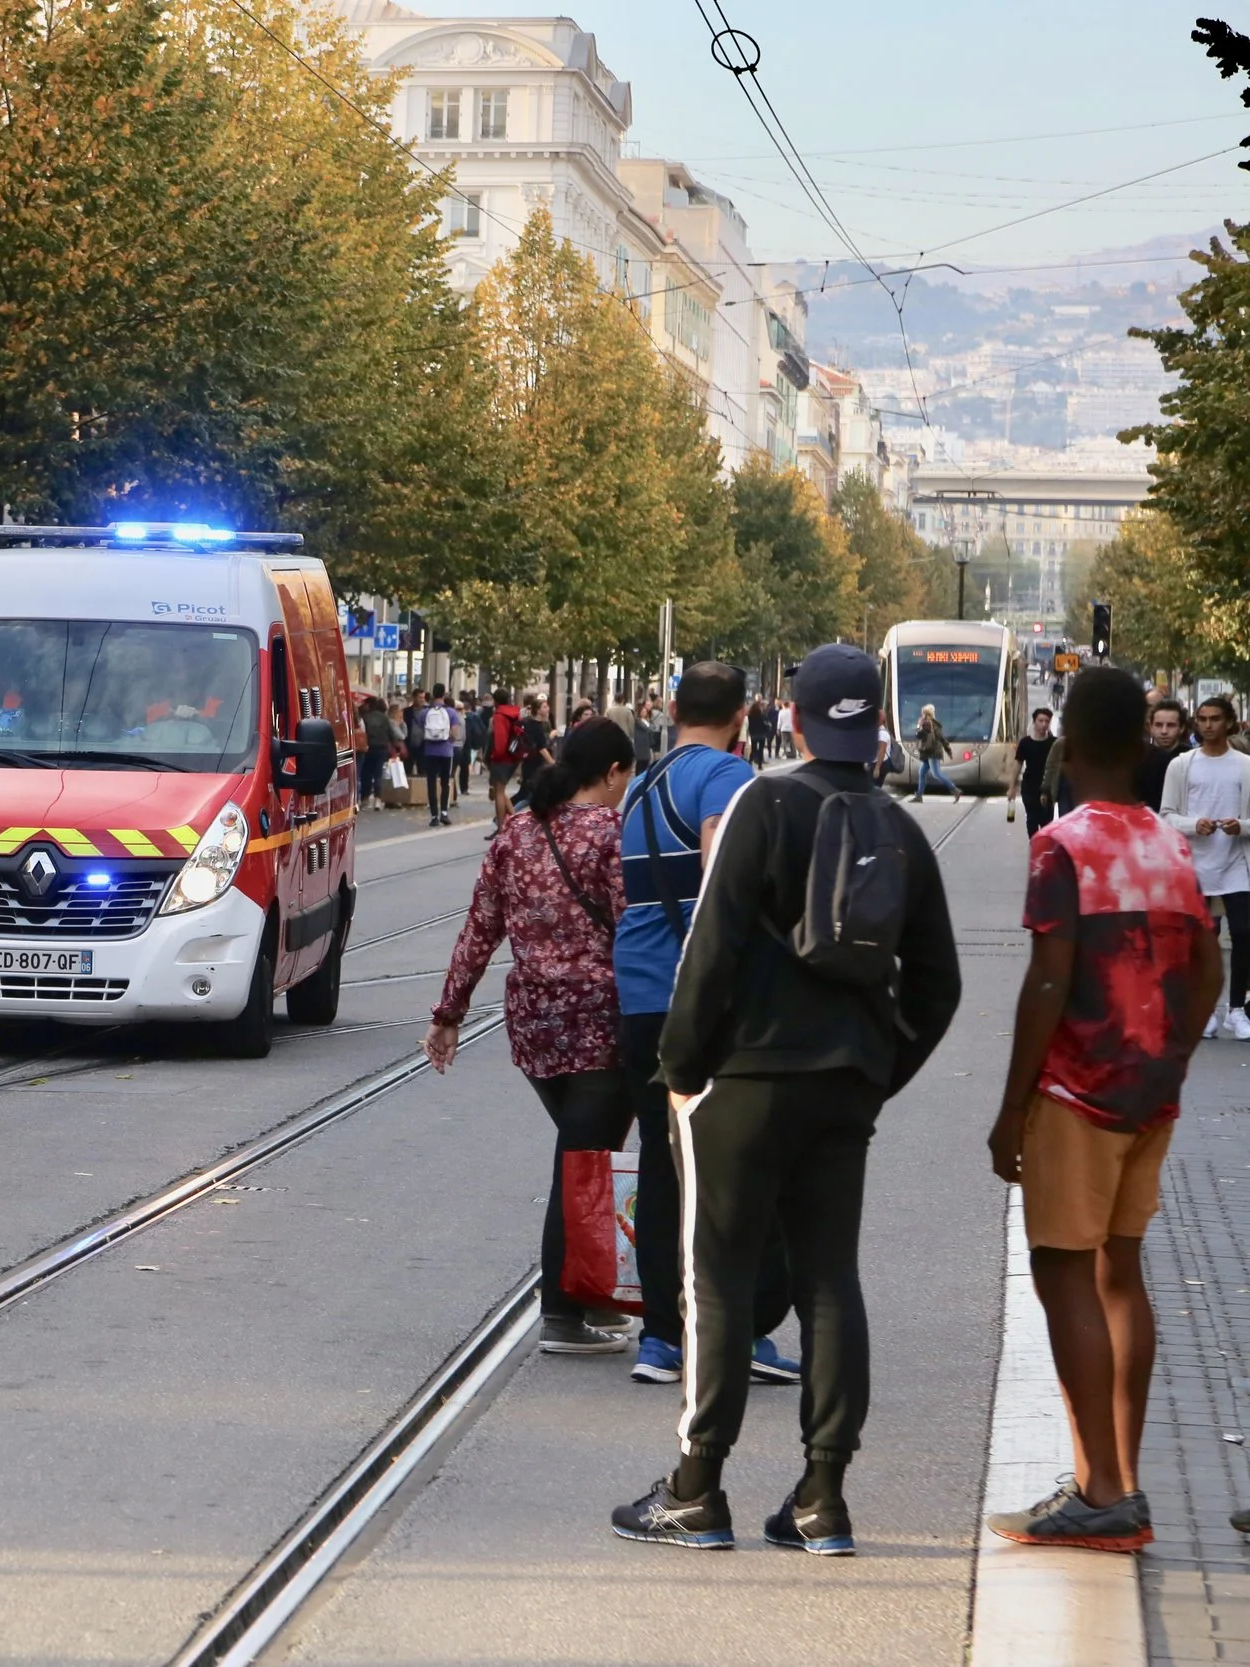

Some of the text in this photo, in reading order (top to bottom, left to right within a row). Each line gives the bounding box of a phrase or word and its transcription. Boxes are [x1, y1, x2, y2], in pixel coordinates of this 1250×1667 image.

[177, 603, 227, 615] Picot
[194, 615, 227, 623] Gruau
[81, 963, 92, 972] 06
